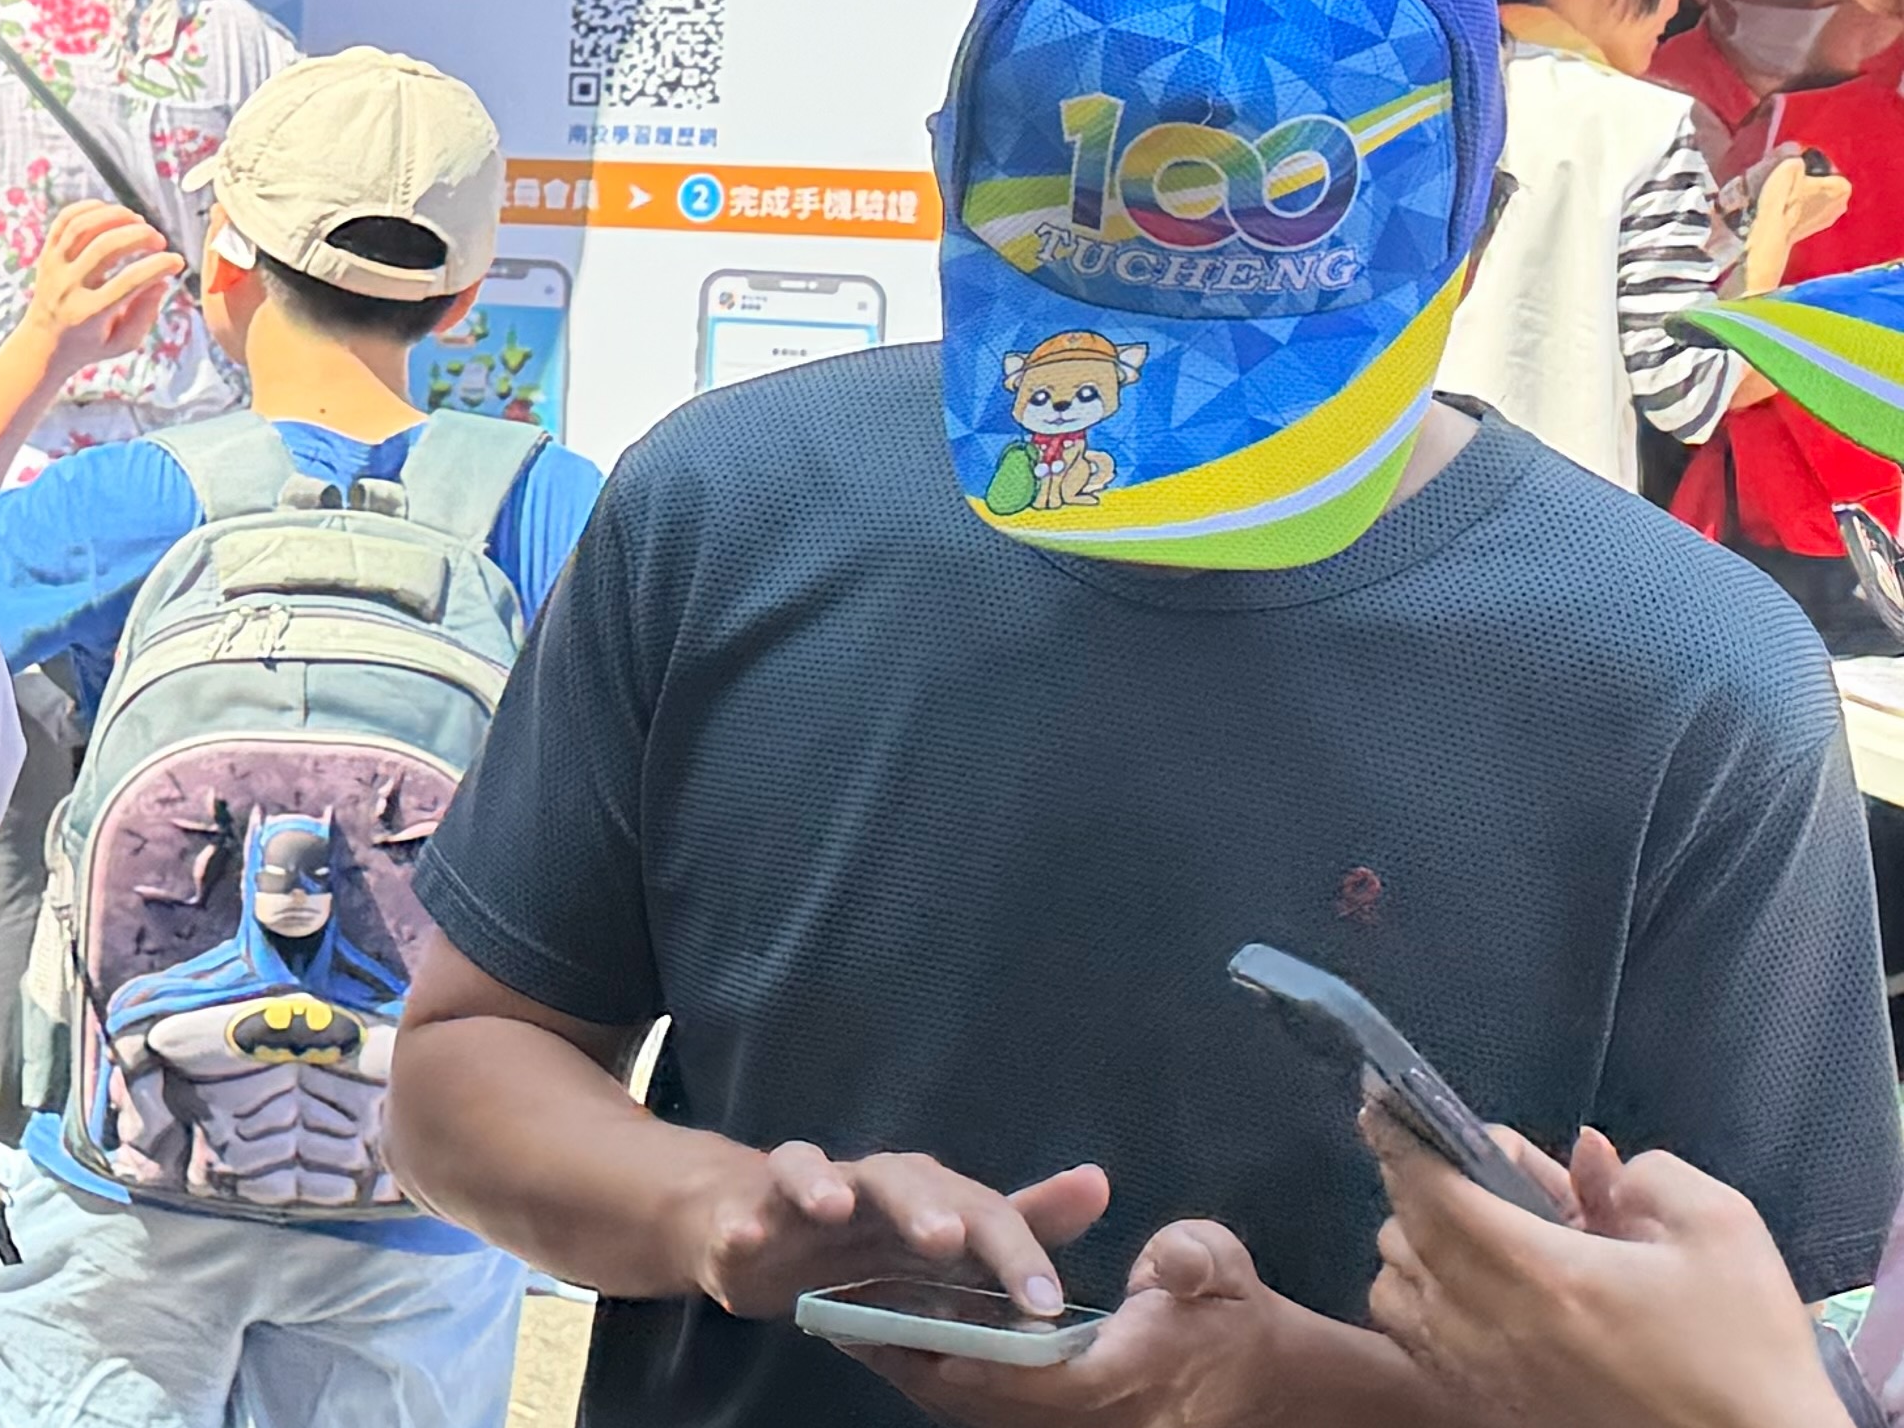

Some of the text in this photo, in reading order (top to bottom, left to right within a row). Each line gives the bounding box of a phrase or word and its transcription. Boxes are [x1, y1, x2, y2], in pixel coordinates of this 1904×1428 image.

[730, 185, 919, 224] 完成手機驗證
[1060, 92, 1362, 252] 100
[1035, 222, 1360, 296] TUCHENG
